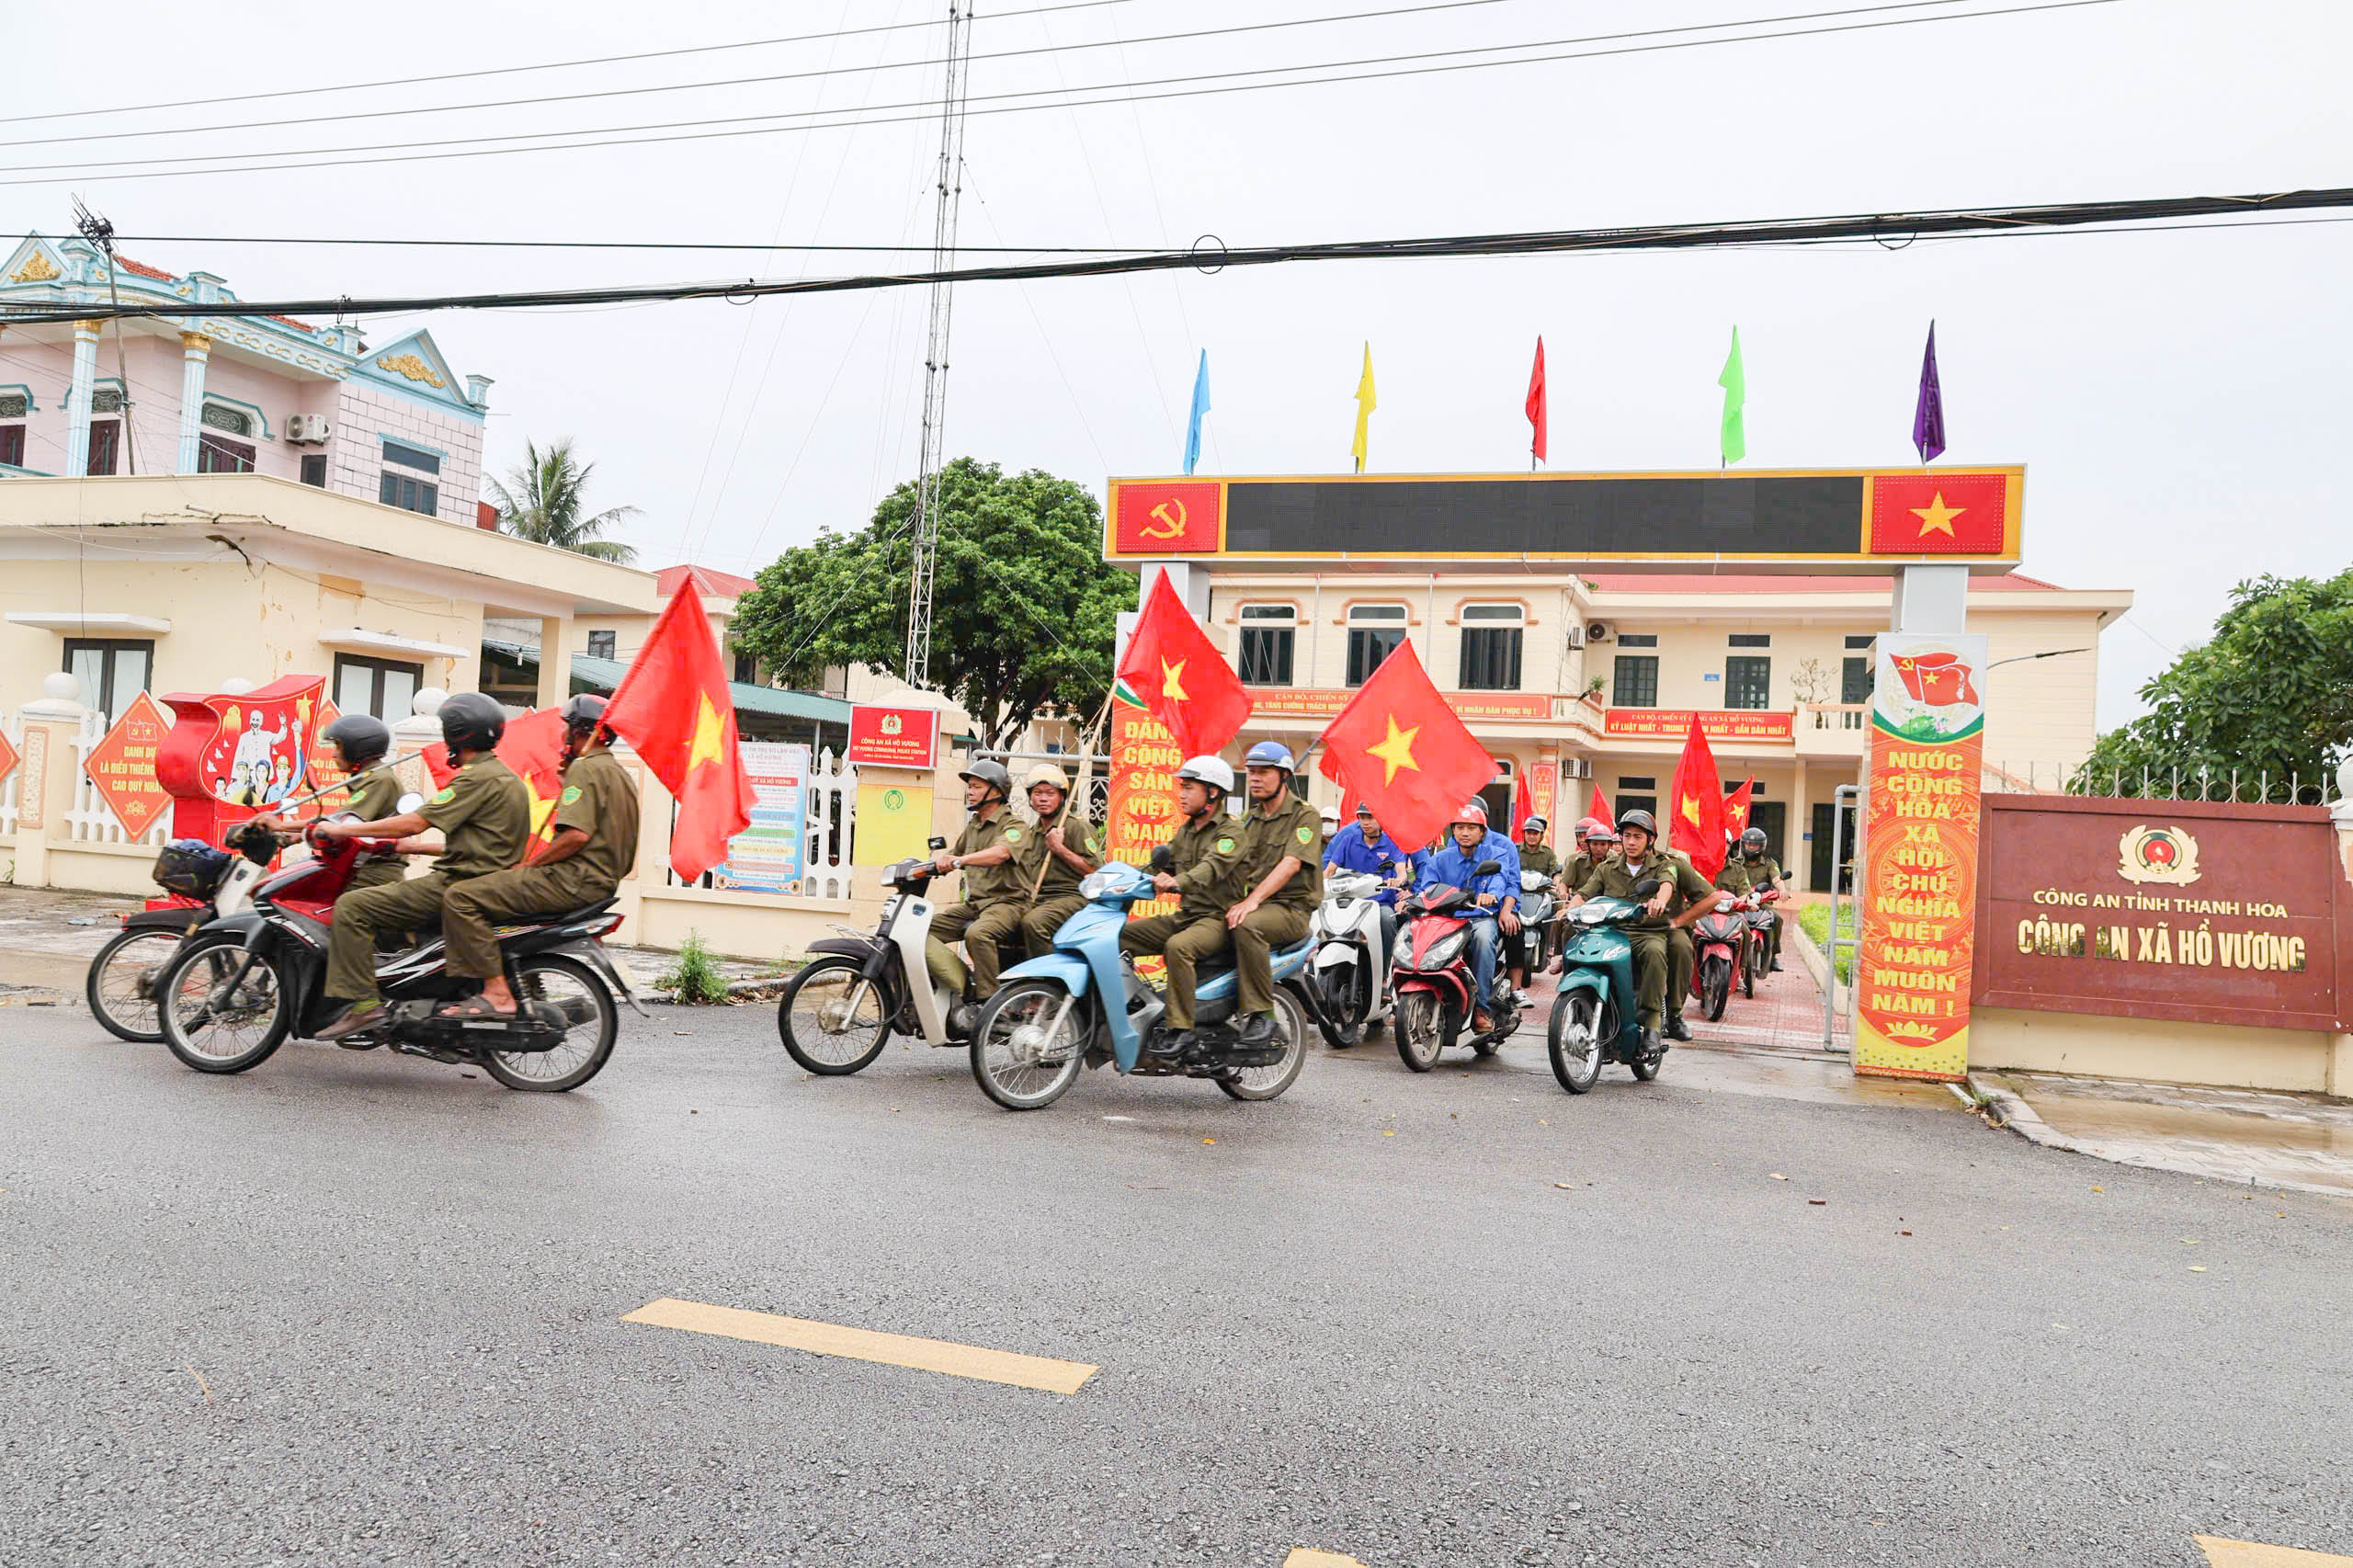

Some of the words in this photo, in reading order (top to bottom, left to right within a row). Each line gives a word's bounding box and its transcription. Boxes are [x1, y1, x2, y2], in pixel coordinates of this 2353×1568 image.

[1464, 705, 1483, 714] NHÂN
[1485, 706, 1500, 714] DÂN
[1124, 717, 1175, 740] ĐẢN
[1638, 722, 1655, 732] NHẤT
[1711, 723, 1728, 734] NHẤT
[1768, 724, 1786, 735] NHẤT
[1124, 744, 1181, 767] CỘNG
[1889, 750, 1963, 770] NƯỚC
[112, 779, 127, 791] CAO
[1129, 767, 1173, 790] SẢN
[1888, 774, 1962, 798] CỘNG
[1128, 795, 1170, 819] VIỆT
[1896, 799, 1950, 819] HÒA
[1124, 823, 1173, 841] NAM
[1904, 823, 1941, 843] XÃ
[1897, 846, 1944, 870] HỘI
[1893, 870, 1948, 892] CHỦ
[1877, 896, 1961, 918] NGHĨA
[2033, 887, 2088, 907] CÔNG
[2092, 894, 2120, 909] AN
[2124, 891, 2169, 912] TỈNH
[2174, 898, 2240, 916] THANH
[2245, 899, 2288, 918] HÓA
[1889, 920, 1947, 944] VIỆT
[2018, 913, 2086, 959] CÔNG
[2095, 926, 2129, 961] AN
[2137, 922, 2173, 964] XÃ
[2178, 918, 2212, 966] HỒ
[1884, 946, 1949, 967] NAM
[1874, 969, 1957, 993] MUÔN
[1872, 993, 1936, 1016] NĂM
